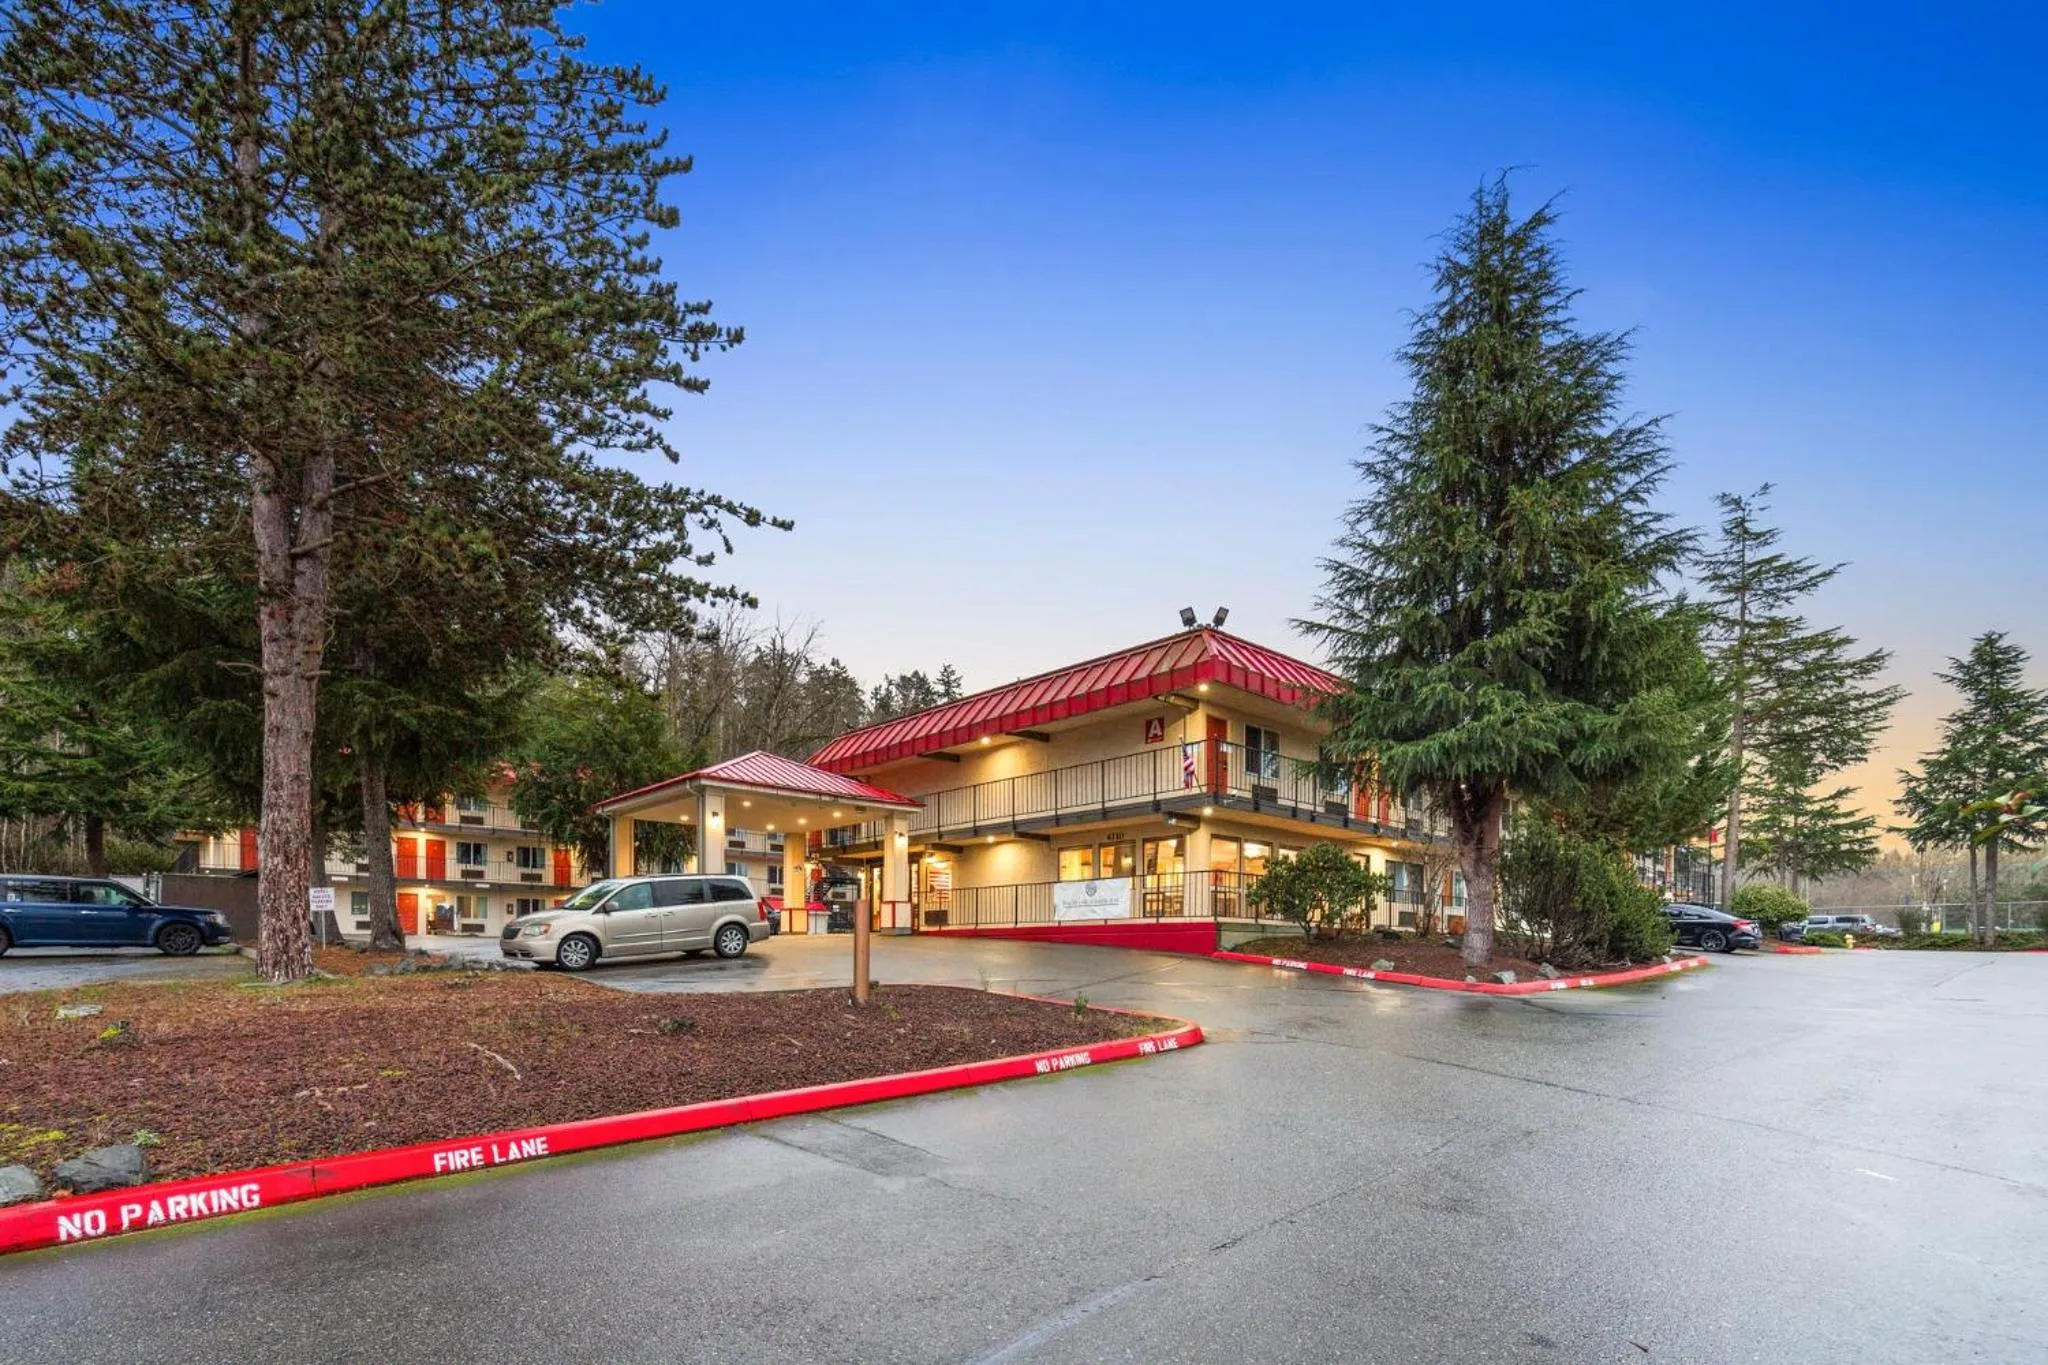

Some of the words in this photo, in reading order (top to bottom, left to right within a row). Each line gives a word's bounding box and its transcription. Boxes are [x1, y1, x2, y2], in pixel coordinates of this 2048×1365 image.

[1157, 1037, 1179, 1051] LANE
[1035, 1059, 1050, 1073] NO
[1051, 1051, 1091, 1071] PARKING
[433, 1145, 485, 1173] FIRE
[493, 1136, 549, 1164] LANE
[57, 1208, 106, 1242] NO
[121, 1183, 261, 1231] PARKING
